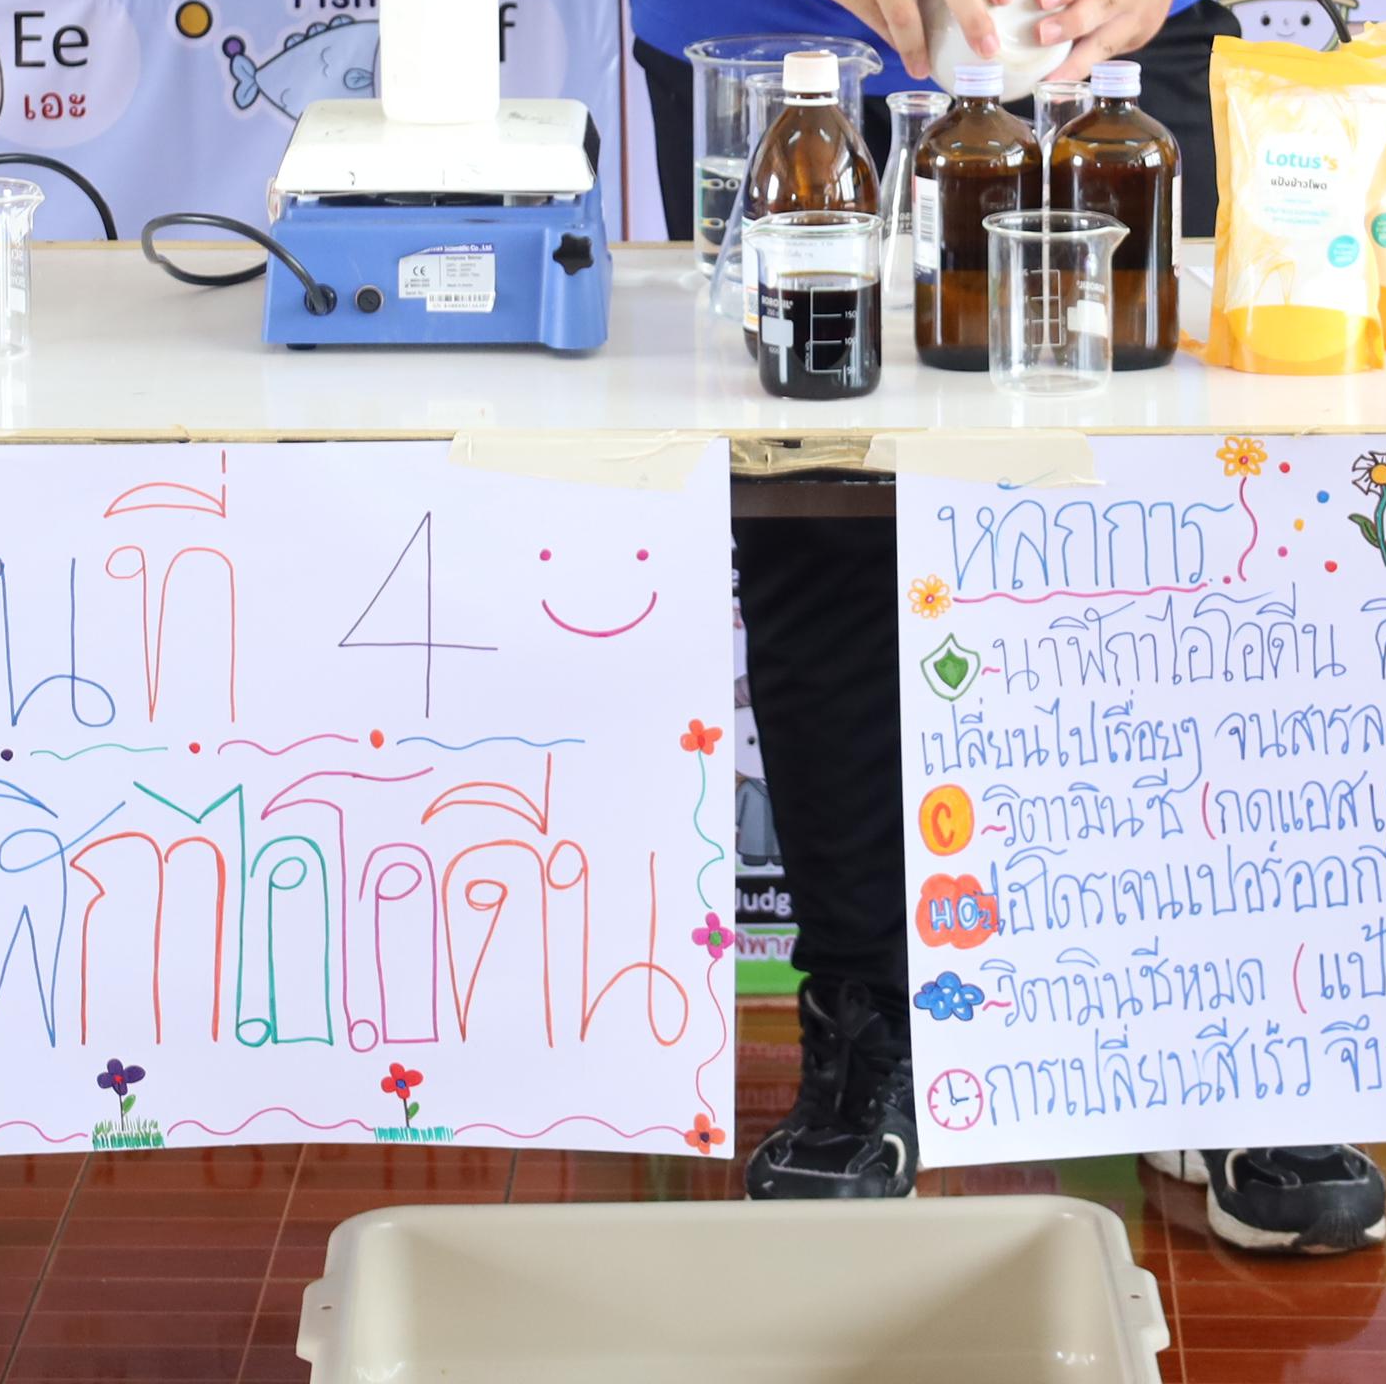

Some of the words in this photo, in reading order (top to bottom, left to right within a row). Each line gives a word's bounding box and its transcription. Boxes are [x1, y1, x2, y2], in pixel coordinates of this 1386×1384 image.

[13, 10, 90, 68] Ee
[499, 1, 518, 63] f
[23, 92, 86, 120] เอะ
[1264, 149, 1338, 171] Lotus's
[936, 470, 1235, 591] หลักการ
[338, 509, 498, 719] 4
[735, 885, 793, 918] Judg
